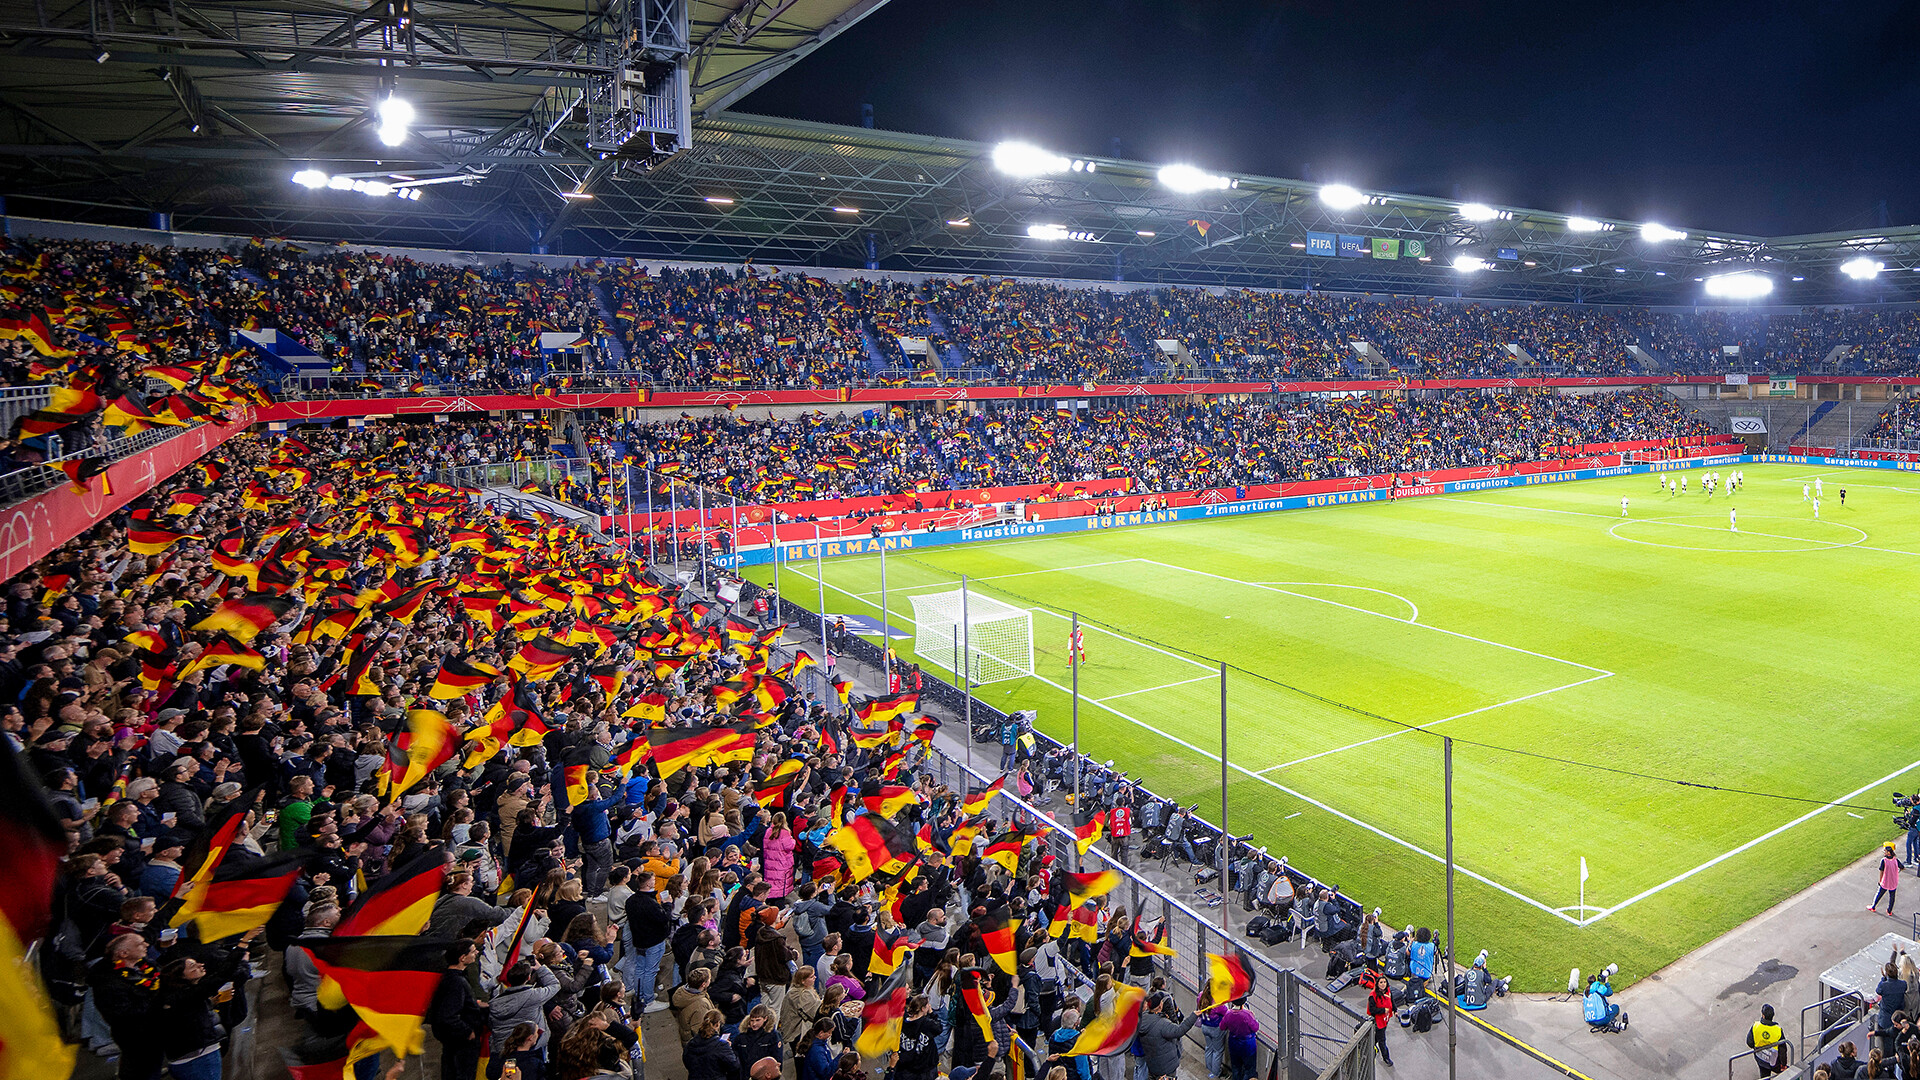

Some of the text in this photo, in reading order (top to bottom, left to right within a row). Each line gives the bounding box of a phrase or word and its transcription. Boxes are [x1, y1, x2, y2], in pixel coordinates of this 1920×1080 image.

[1310, 238, 1332, 249] FIFA
[1341, 242, 1360, 251] UEFA
[1649, 461, 1691, 472] HÖRMANN
[1702, 457, 1740, 466] Zimmertüren
[1824, 457, 1878, 467] Garagentore
[1526, 472, 1577, 484] HÖRMANN
[1454, 479, 1509, 491] Garagentore
[1396, 486, 1435, 497] DUISBURG
[1307, 491, 1377, 507] HÖRMANN
[1205, 501, 1283, 515] Zimmertüren
[1087, 510, 1178, 528] HÖRMANN
[961, 523, 1045, 540] Haustüren
[788, 535, 913, 560] HÖRMANN
